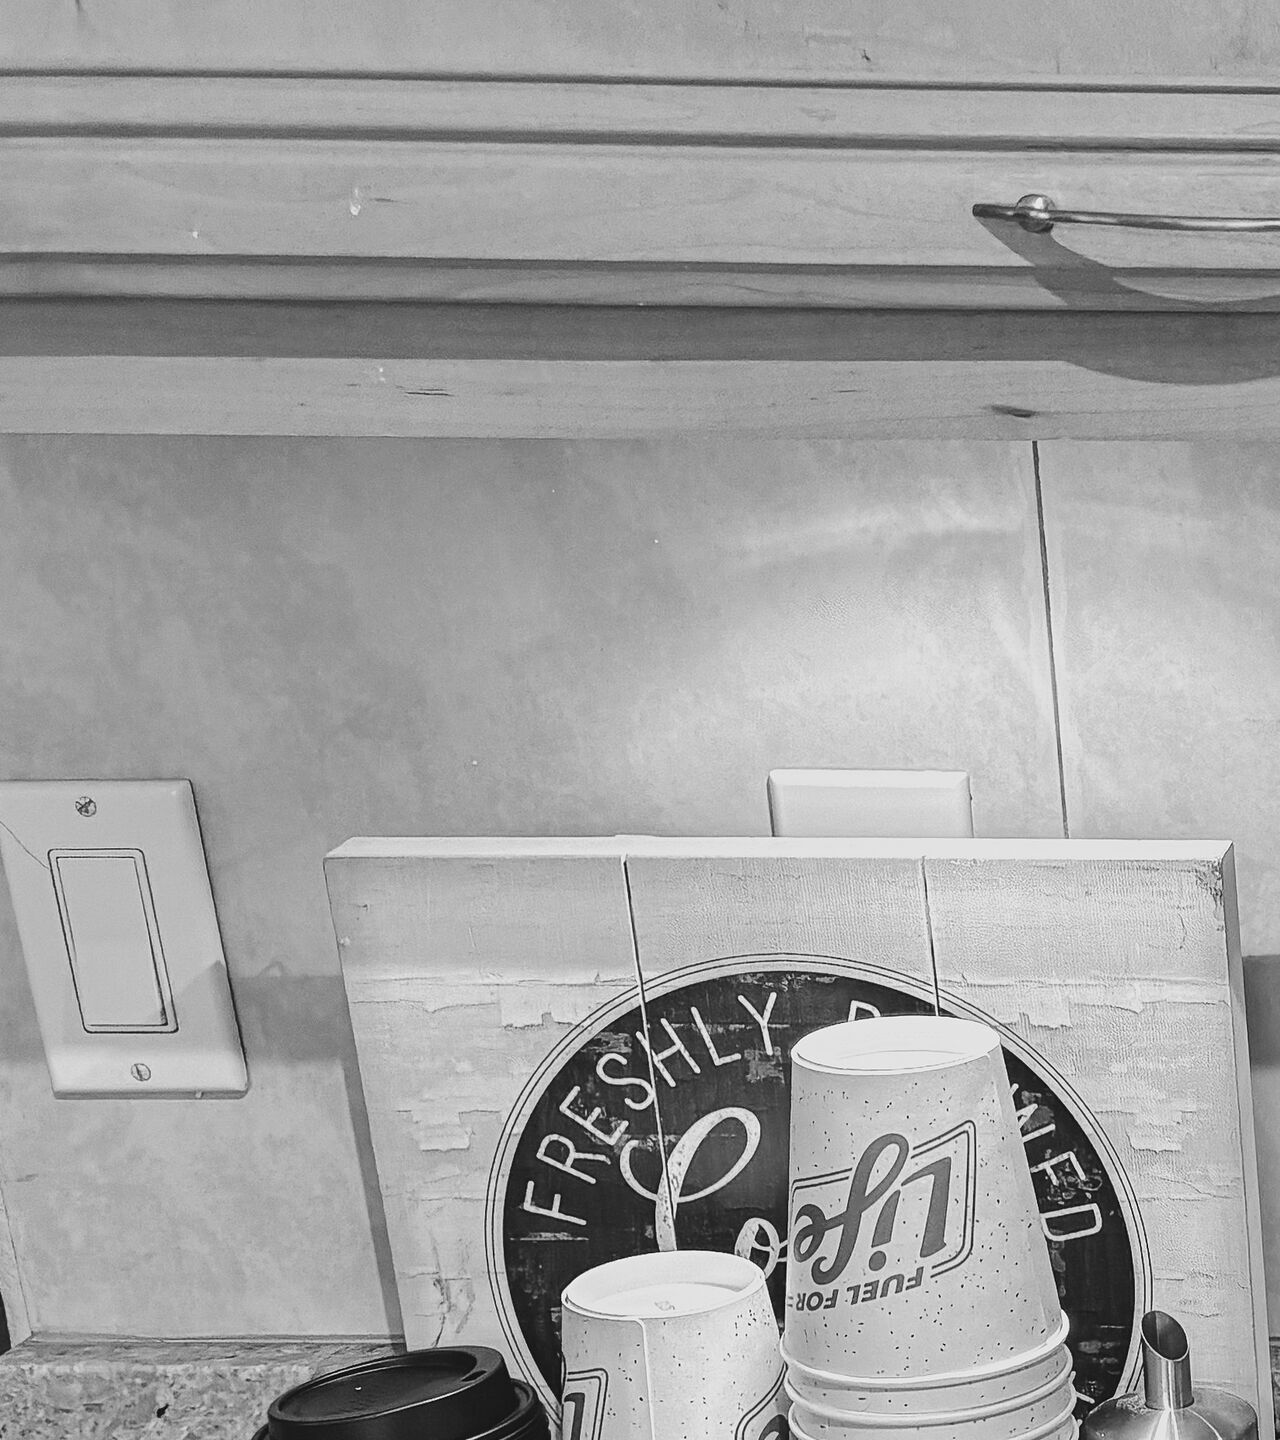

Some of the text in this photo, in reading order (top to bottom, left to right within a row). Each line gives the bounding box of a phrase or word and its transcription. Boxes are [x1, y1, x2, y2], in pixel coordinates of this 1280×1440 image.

[522, 991, 778, 1226] FRESHLY
[794, 1133, 951, 1285] Life
[796, 1266, 924, 1311] FUEL FOR
